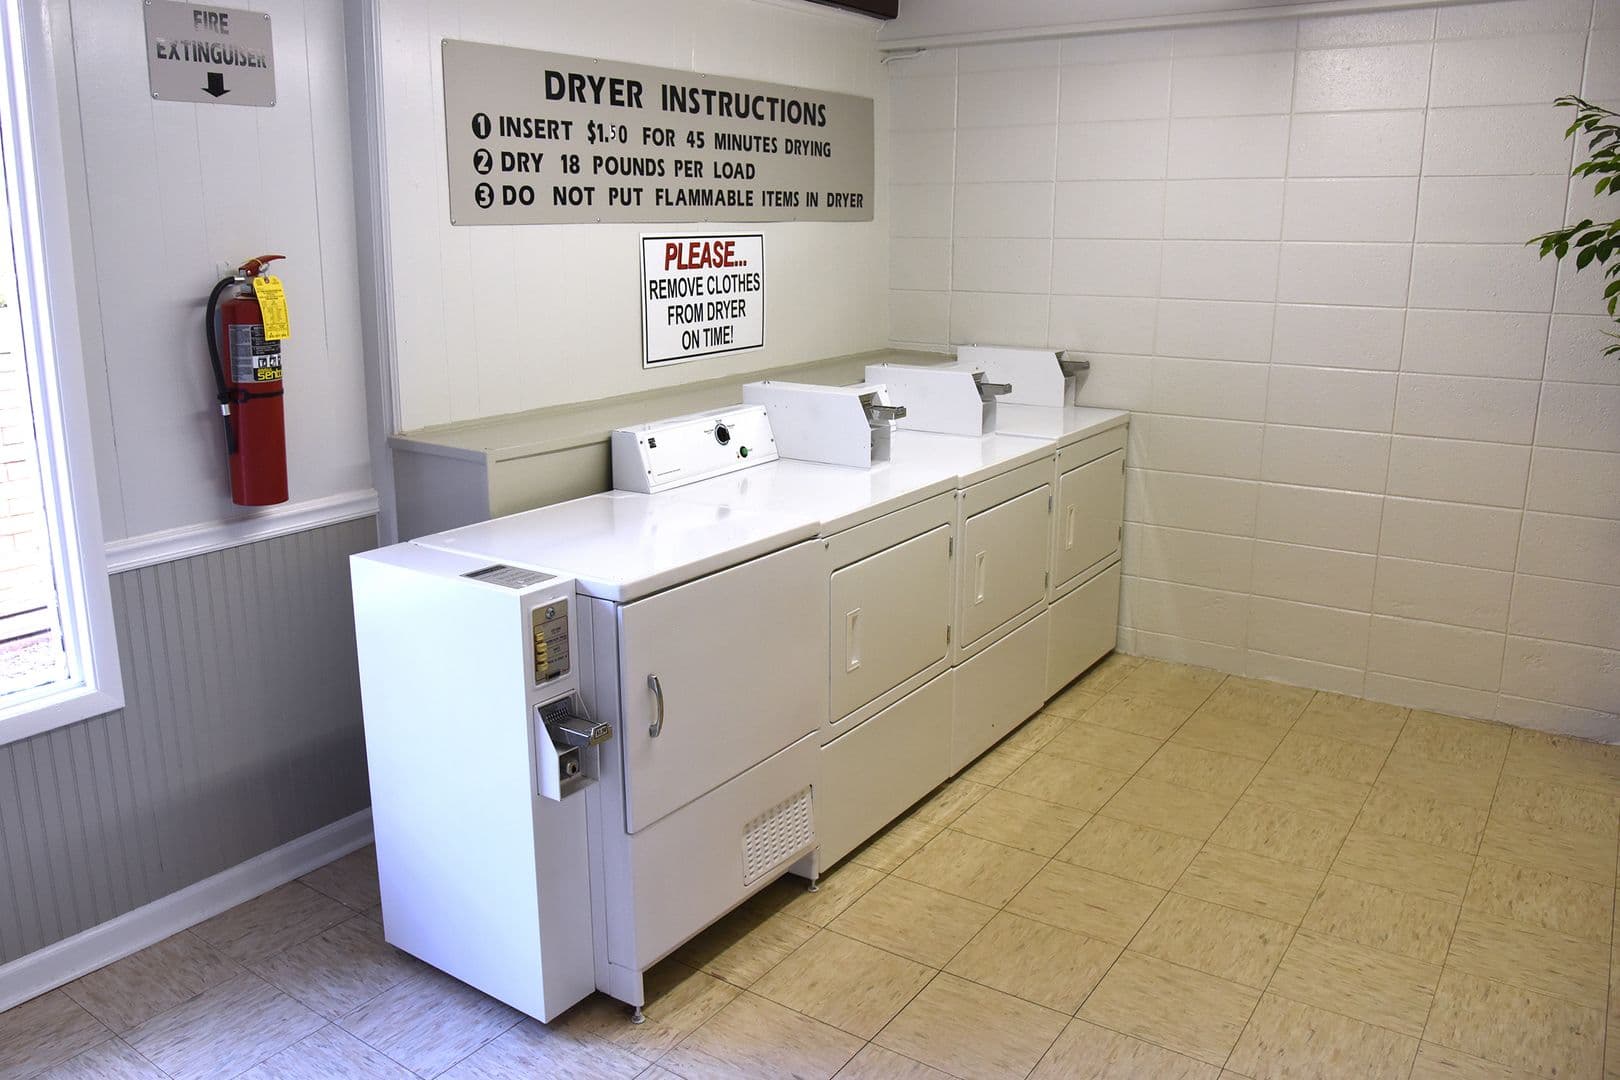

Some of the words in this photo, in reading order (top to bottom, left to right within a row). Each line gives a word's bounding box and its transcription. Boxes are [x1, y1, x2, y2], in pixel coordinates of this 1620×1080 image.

[193, 10, 230, 35] FIRE
[544, 69, 644, 109] DRYER
[661, 82, 827, 128] INSTRUCTIONS
[499, 115, 574, 141] INSERT
[587, 119, 628, 145] $1.50
[642, 126, 676, 148] FOR
[686, 130, 706, 149] 45
[714, 132, 778, 154] MINUTES
[784, 137, 832, 158] DRYING
[500, 150, 544, 173] DRY
[560, 153, 581, 175] 18
[592, 155, 666, 178] POUNDS
[674, 159, 704, 179] PER
[713, 160, 756, 180] LOAD
[502, 184, 535, 206] DO
[552, 185, 596, 206] NOT
[608, 186, 644, 207] PUT
[655, 187, 754, 207] FLAMMABLE
[761, 190, 800, 208] ITEMS
[805, 191, 819, 208] IN
[826, 191, 864, 209] DRYER
[664, 241, 747, 271] PLEASE...
[649, 276, 704, 300] REMOVE
[706, 272, 761, 296] CLOTHES
[667, 302, 704, 326] FROM
[707, 298, 746, 321] DRYER
[681, 329, 700, 351] ON
[702, 325, 734, 348] TIME!
